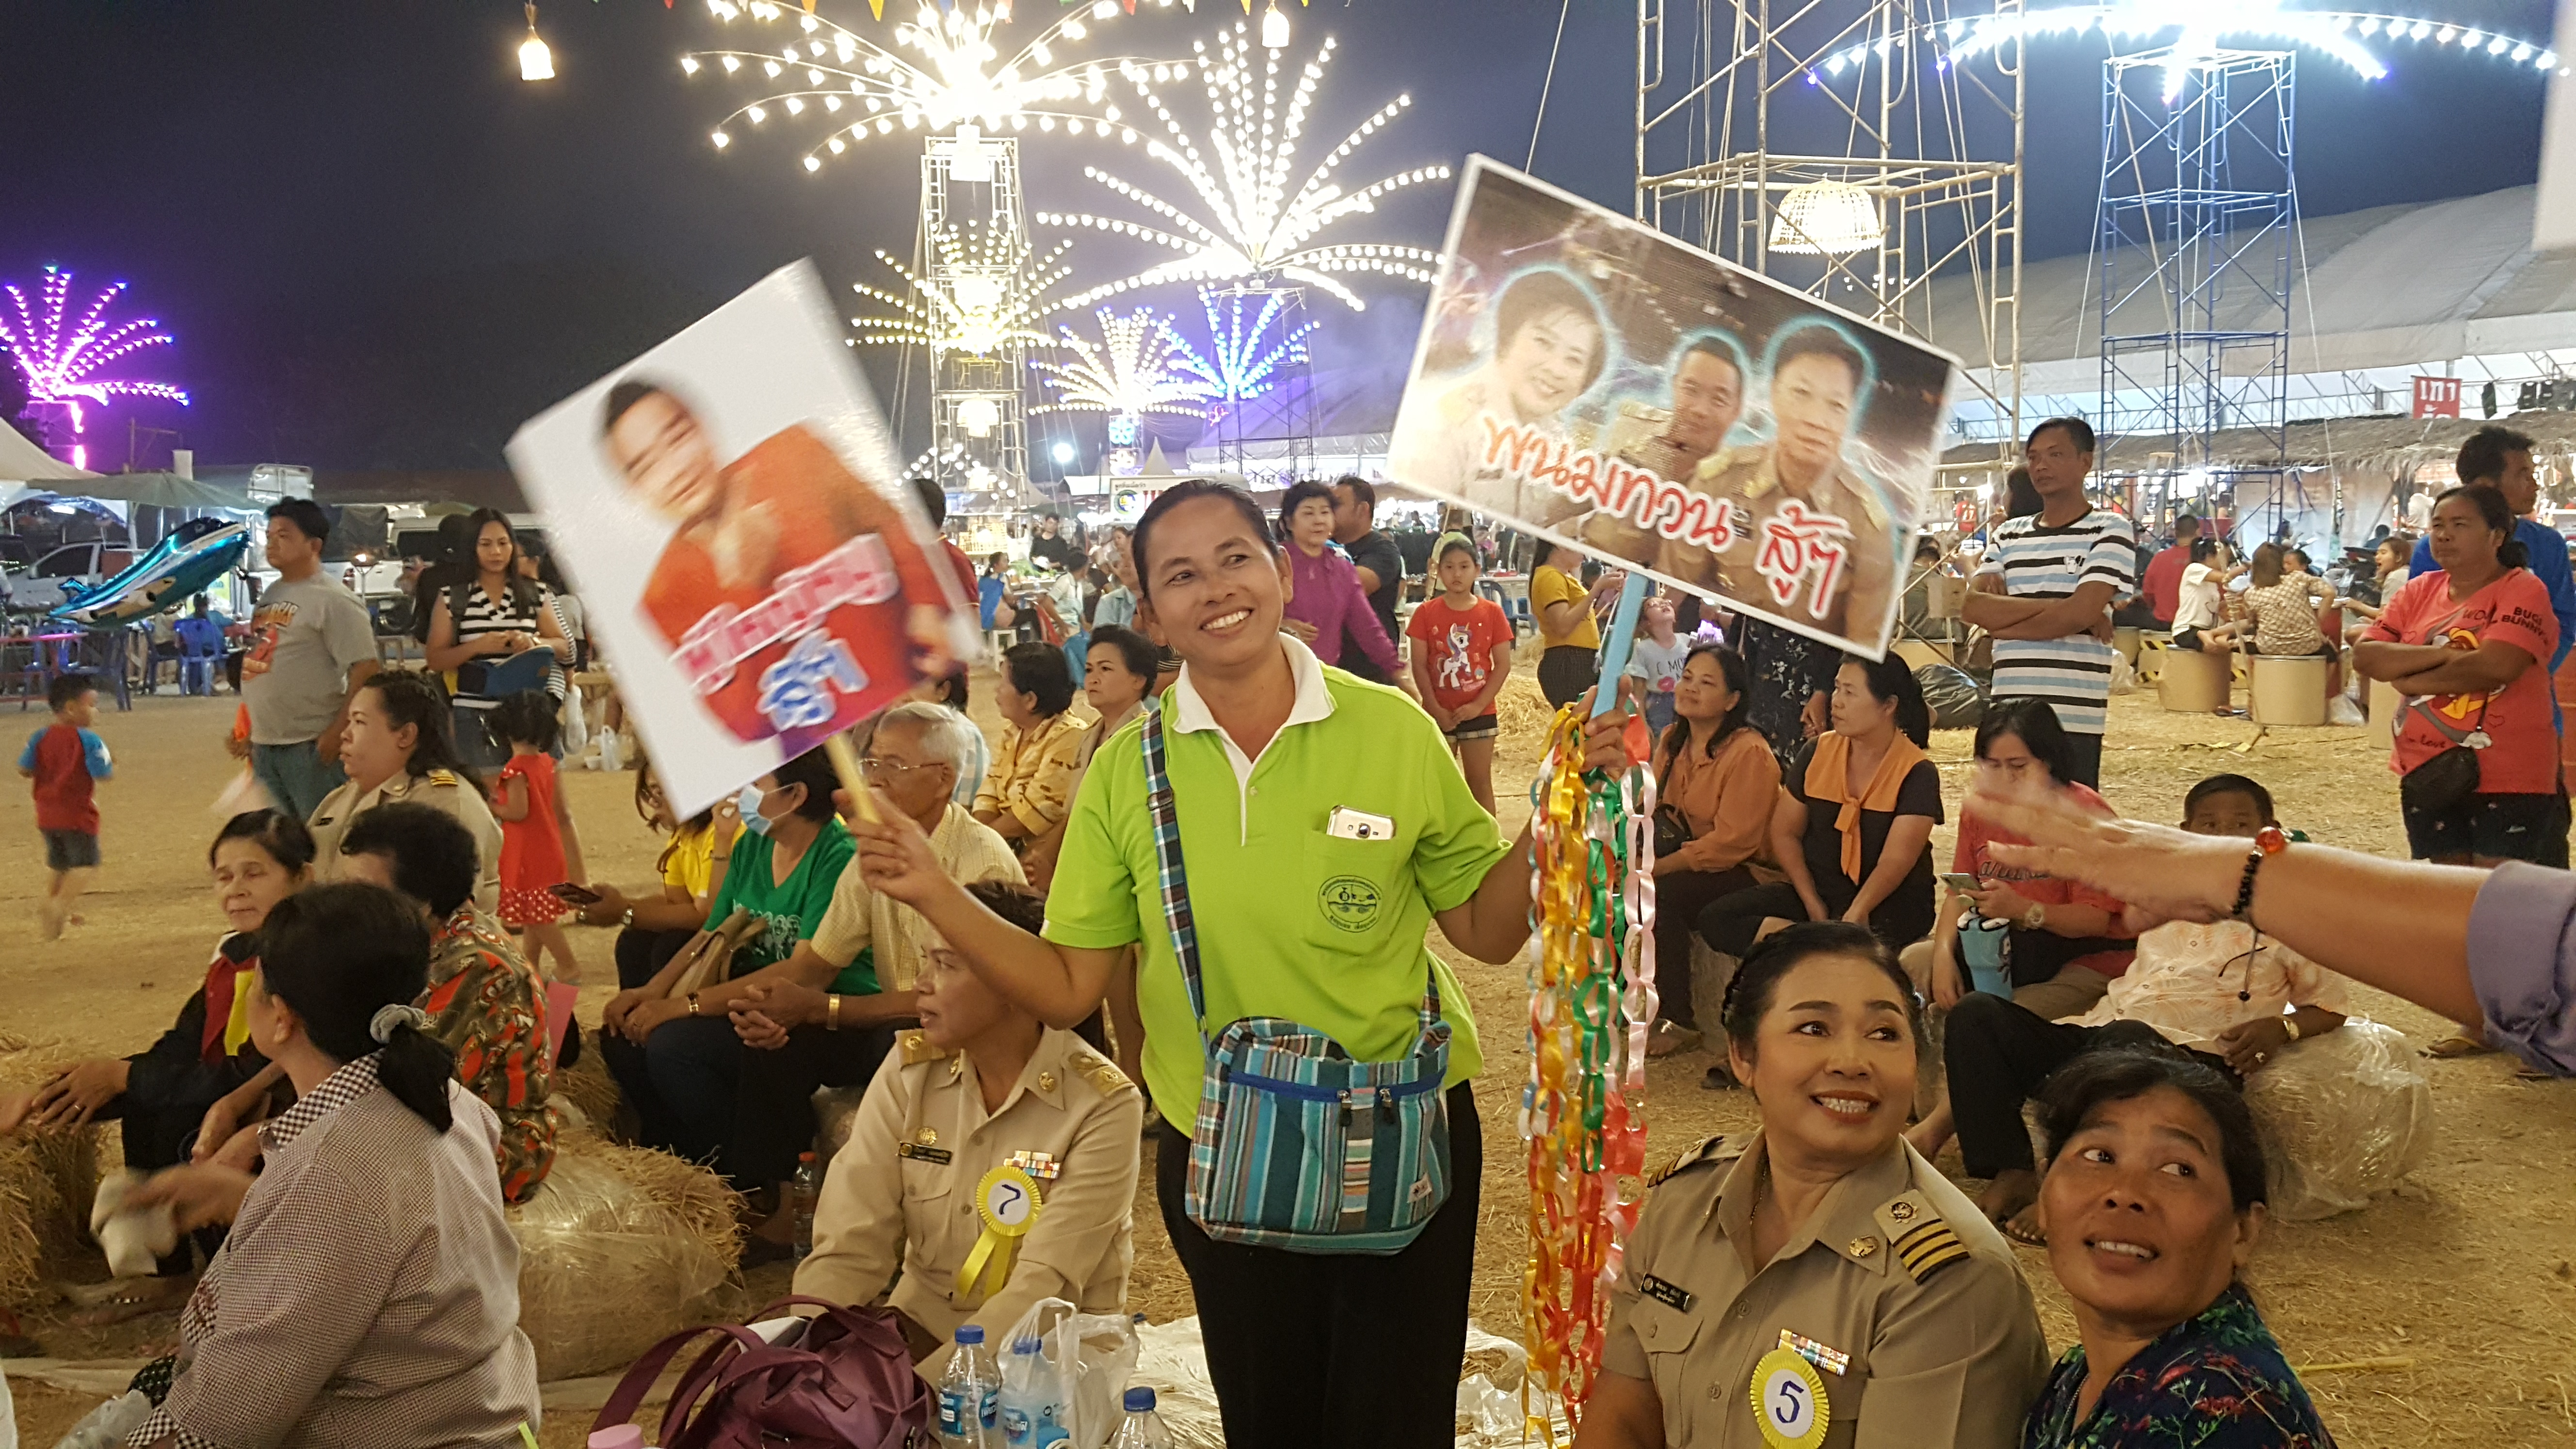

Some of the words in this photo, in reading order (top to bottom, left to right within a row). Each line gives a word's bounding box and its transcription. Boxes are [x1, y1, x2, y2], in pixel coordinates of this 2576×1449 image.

[1484, 416, 1732, 546] พนมทวน
[1762, 505, 1846, 611] สู้ๆ
[999, 1184, 1021, 1215] 7
[1776, 1381, 1804, 1423] 5
